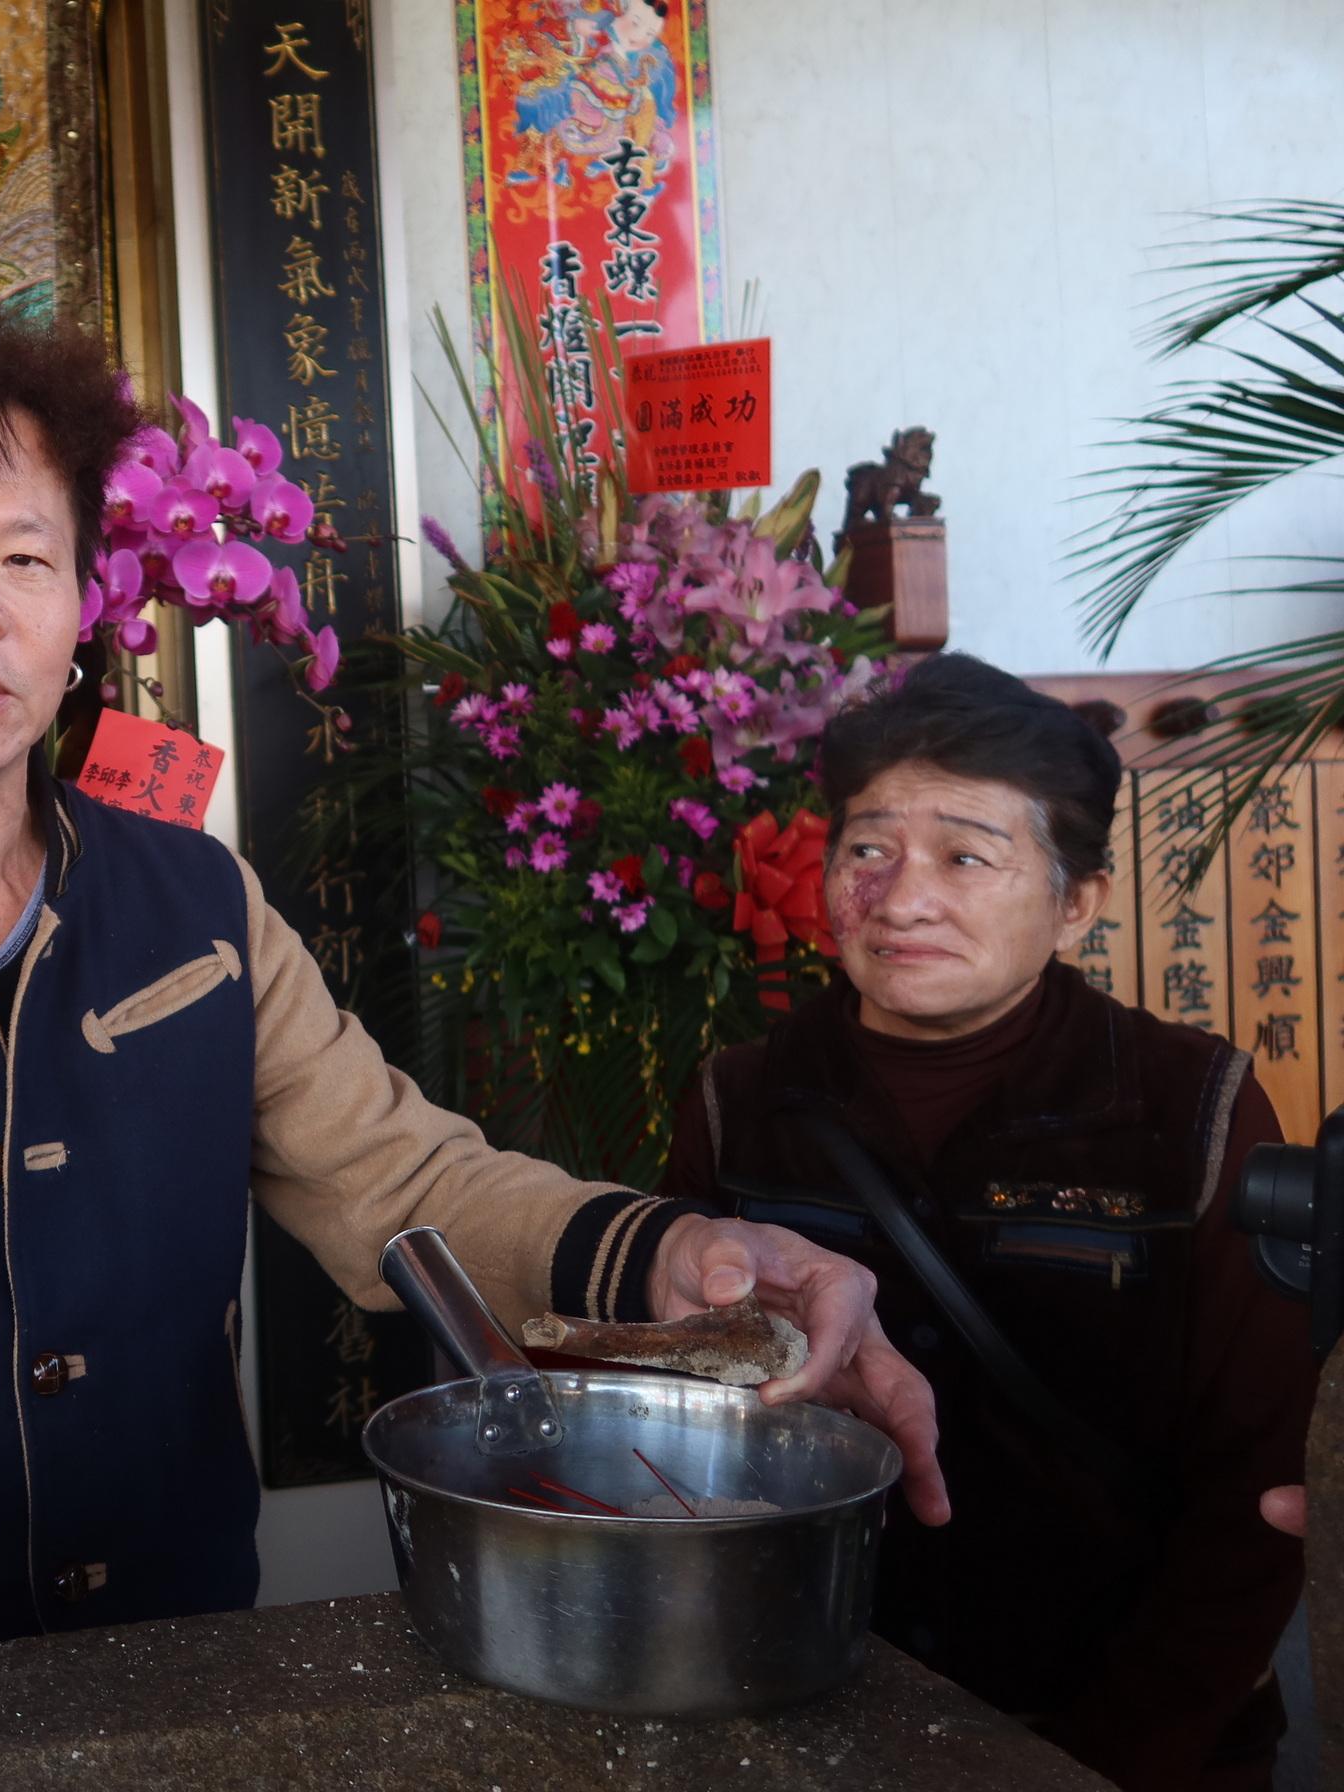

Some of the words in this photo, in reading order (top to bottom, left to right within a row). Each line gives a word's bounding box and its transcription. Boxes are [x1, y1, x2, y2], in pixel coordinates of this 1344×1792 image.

[636, 389, 756, 433] 圓滿成功
[131, 739, 181, 818] 香火
[1158, 786, 1216, 1030] 油郊金隆
